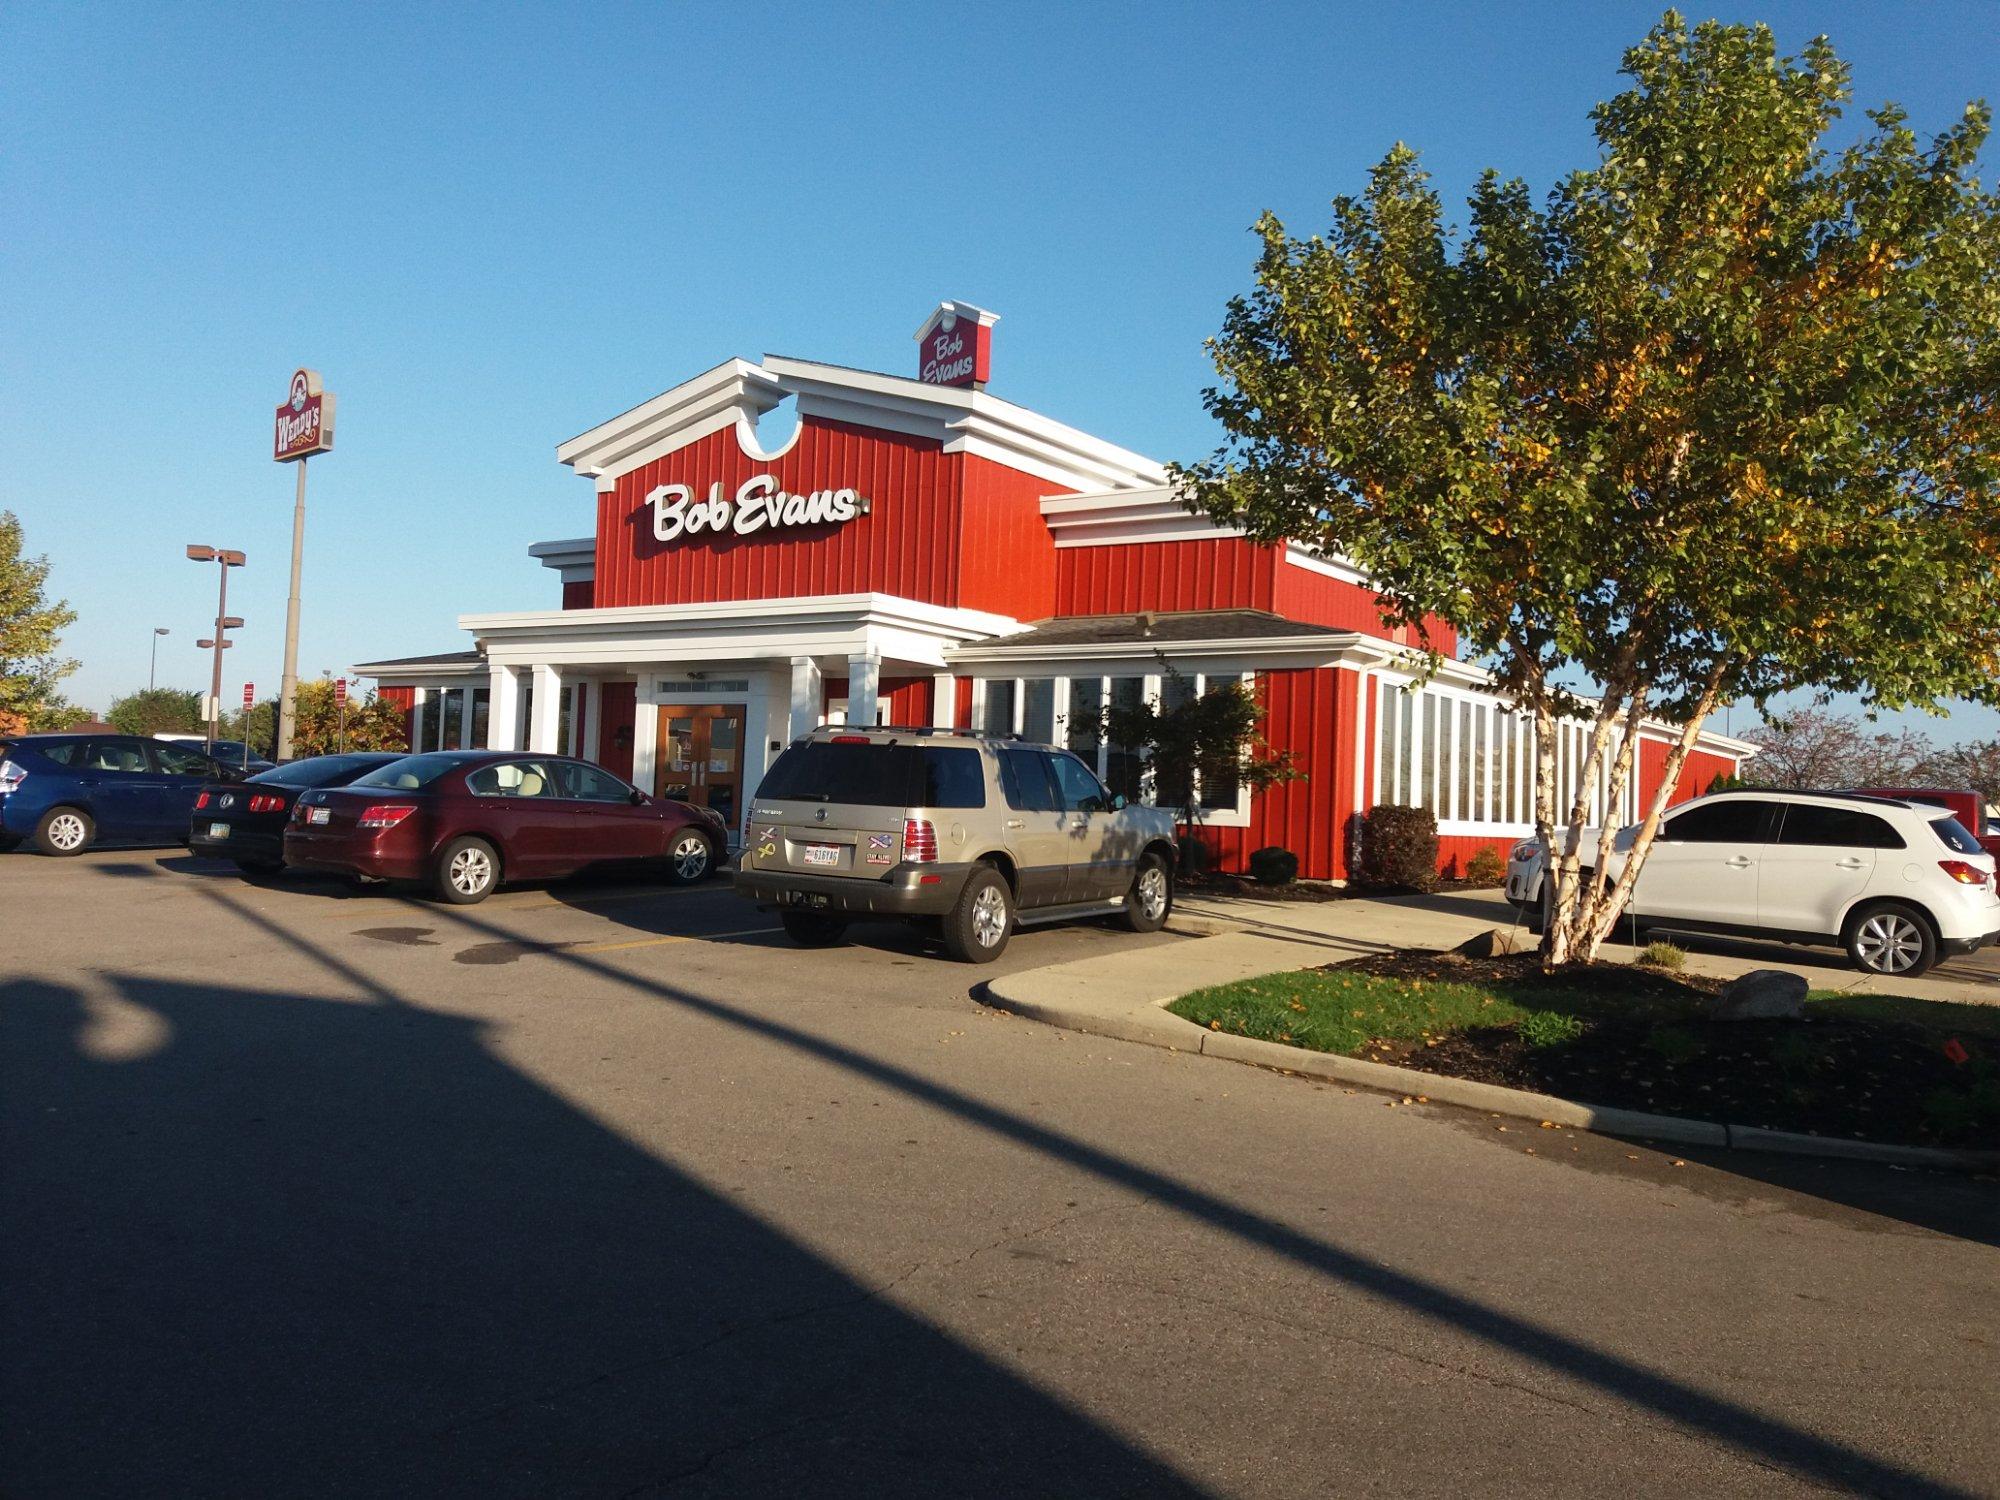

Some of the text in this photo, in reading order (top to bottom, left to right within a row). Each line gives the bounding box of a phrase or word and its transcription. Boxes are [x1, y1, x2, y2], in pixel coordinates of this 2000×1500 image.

[934, 332, 963, 361] Bob
[923, 356, 973, 383] Evans
[645, 474, 857, 542] Bob Evans
